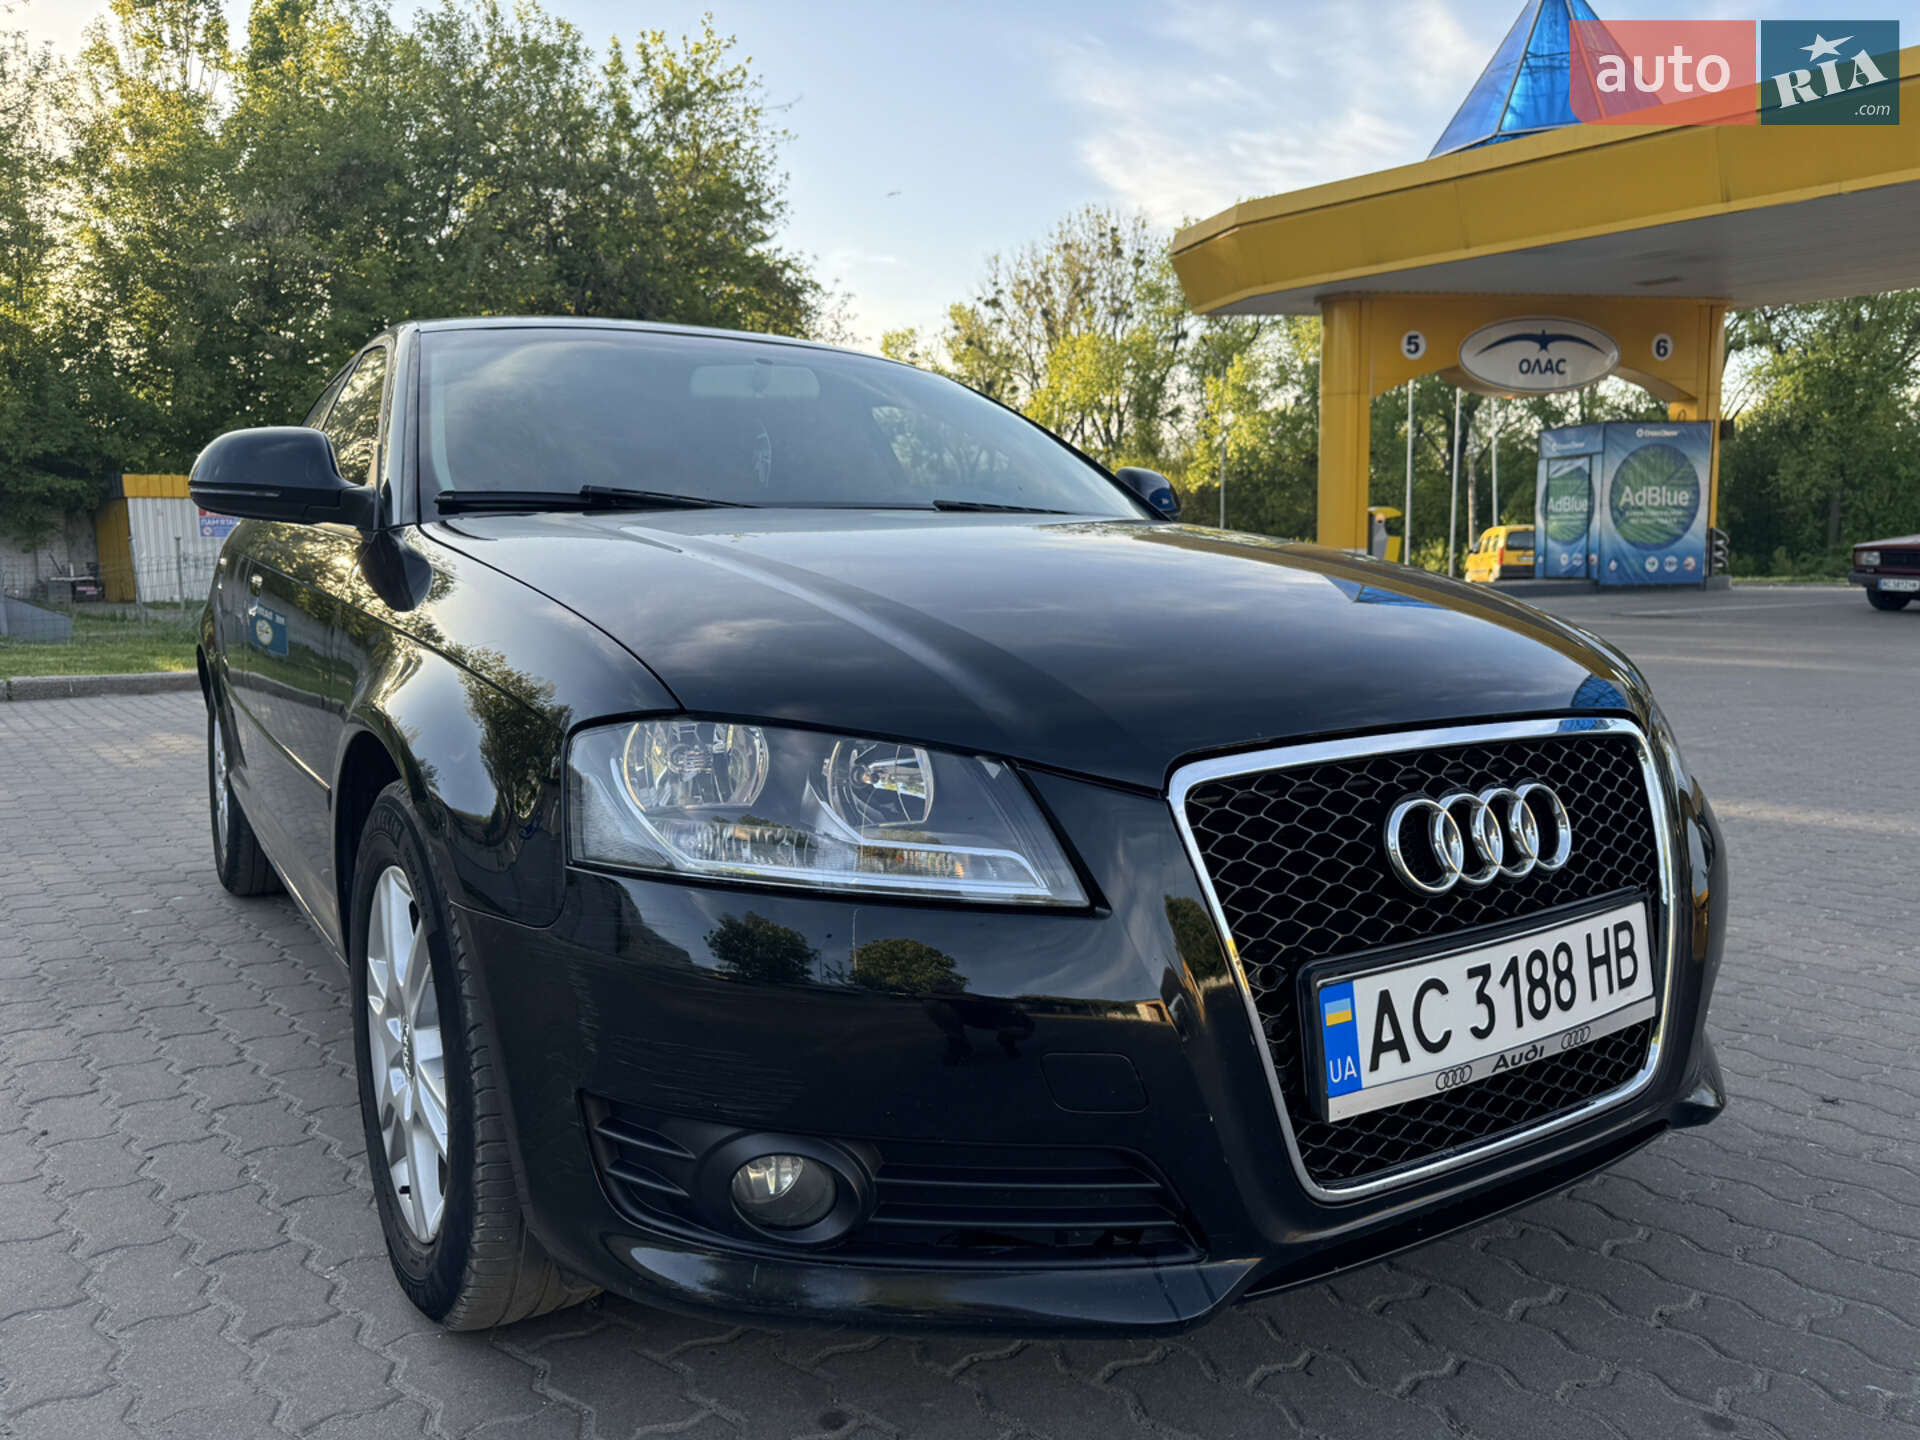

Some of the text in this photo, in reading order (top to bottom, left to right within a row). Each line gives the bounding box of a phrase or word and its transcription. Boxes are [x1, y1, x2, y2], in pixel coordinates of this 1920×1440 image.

[1405, 334, 1420, 354] 5
[1655, 338, 1669, 357] 6
[1547, 496, 1588, 512] AdBlue
[1619, 485, 1690, 507] AdBlue
[1368, 919, 1639, 1073] AC 3188 HB
[1330, 1055, 1357, 1084] UA
[1491, 1044, 1545, 1073] Audi
